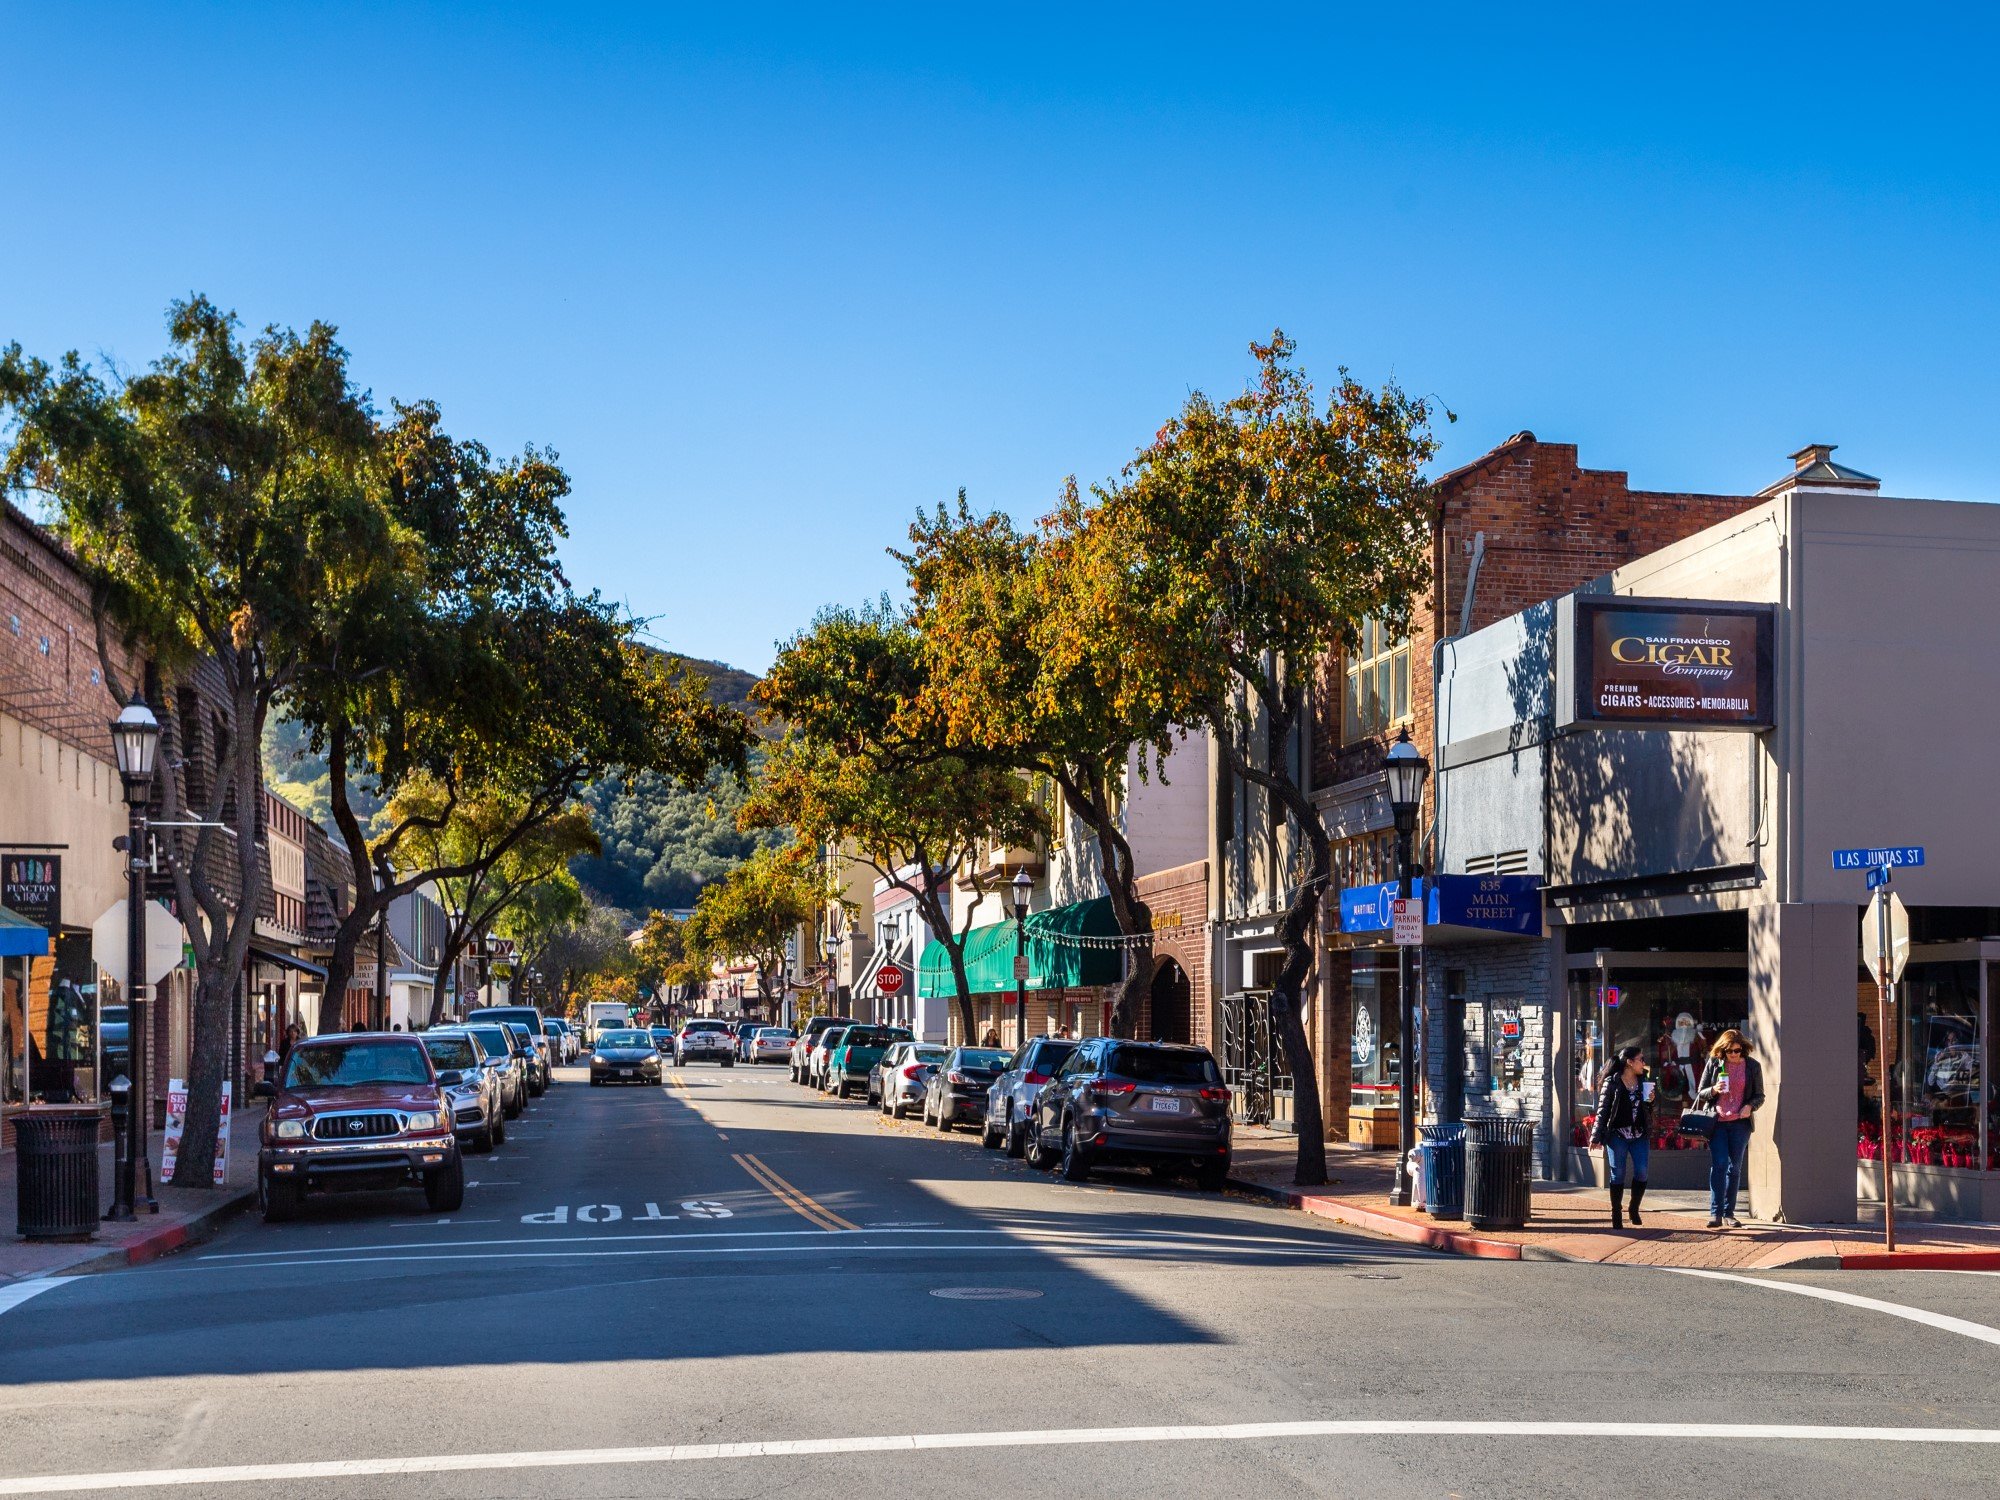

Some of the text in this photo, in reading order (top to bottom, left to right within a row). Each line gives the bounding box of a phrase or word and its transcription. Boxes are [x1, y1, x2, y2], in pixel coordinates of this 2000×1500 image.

[1670, 638, 1730, 646] FRANCISCO
[1611, 637, 1733, 666] CIGAR
[1655, 659, 1733, 680] Company
[1604, 684, 1638, 692] PREMIUM
[1600, 694, 1749, 710] CIGARS ACCESSORIES MEMORABILIA
[1840, 850, 1918, 866] LAS JUNTAS ST
[7, 884, 56, 892] FUNCTION
[1480, 880, 1500, 890] 835
[1472, 894, 1509, 904] MAIN
[1394, 902, 1405, 912] NO
[1466, 908, 1515, 918] STREET
[1396, 915, 1420, 923] PARKING
[878, 974, 902, 984] STOP
[520, 1201, 734, 1224] STOP
